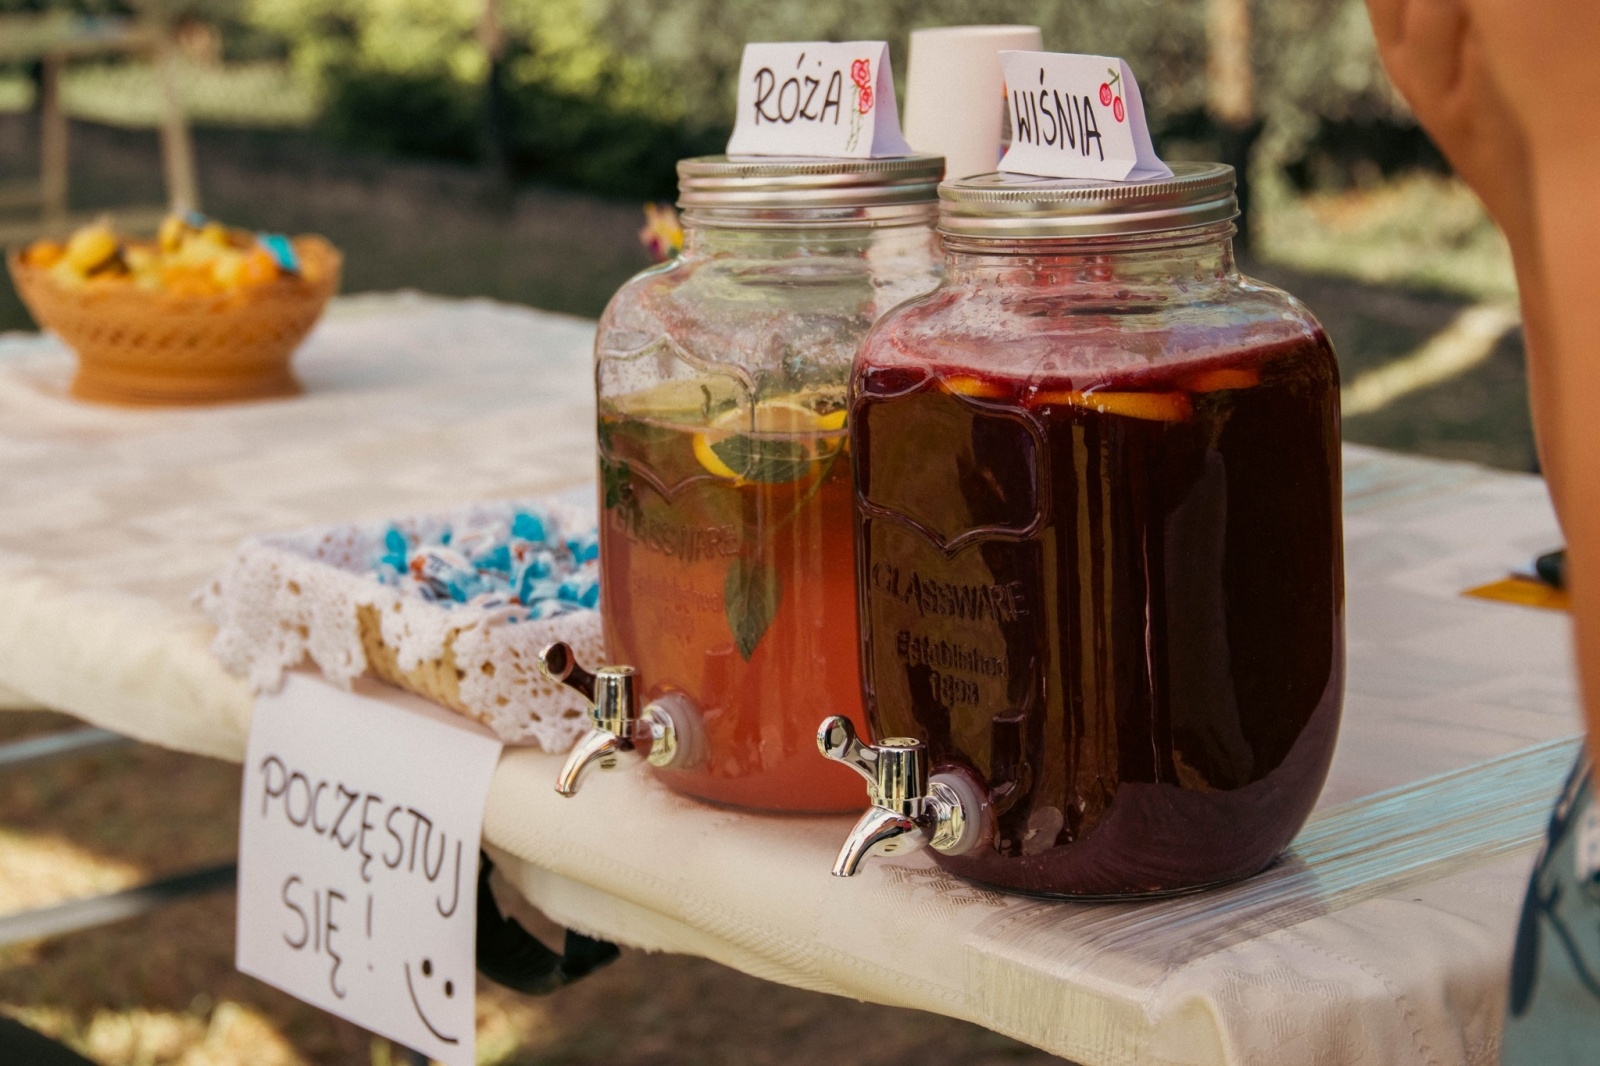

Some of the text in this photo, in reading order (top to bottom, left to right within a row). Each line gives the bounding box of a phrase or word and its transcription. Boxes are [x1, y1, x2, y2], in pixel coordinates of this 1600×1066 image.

[753, 52, 842, 126] RÓŻA
[1013, 67, 1104, 162] WIŚNIA
[872, 560, 1031, 623] GLASSWARE
[260, 754, 463, 919] POCZĘSTUJ
